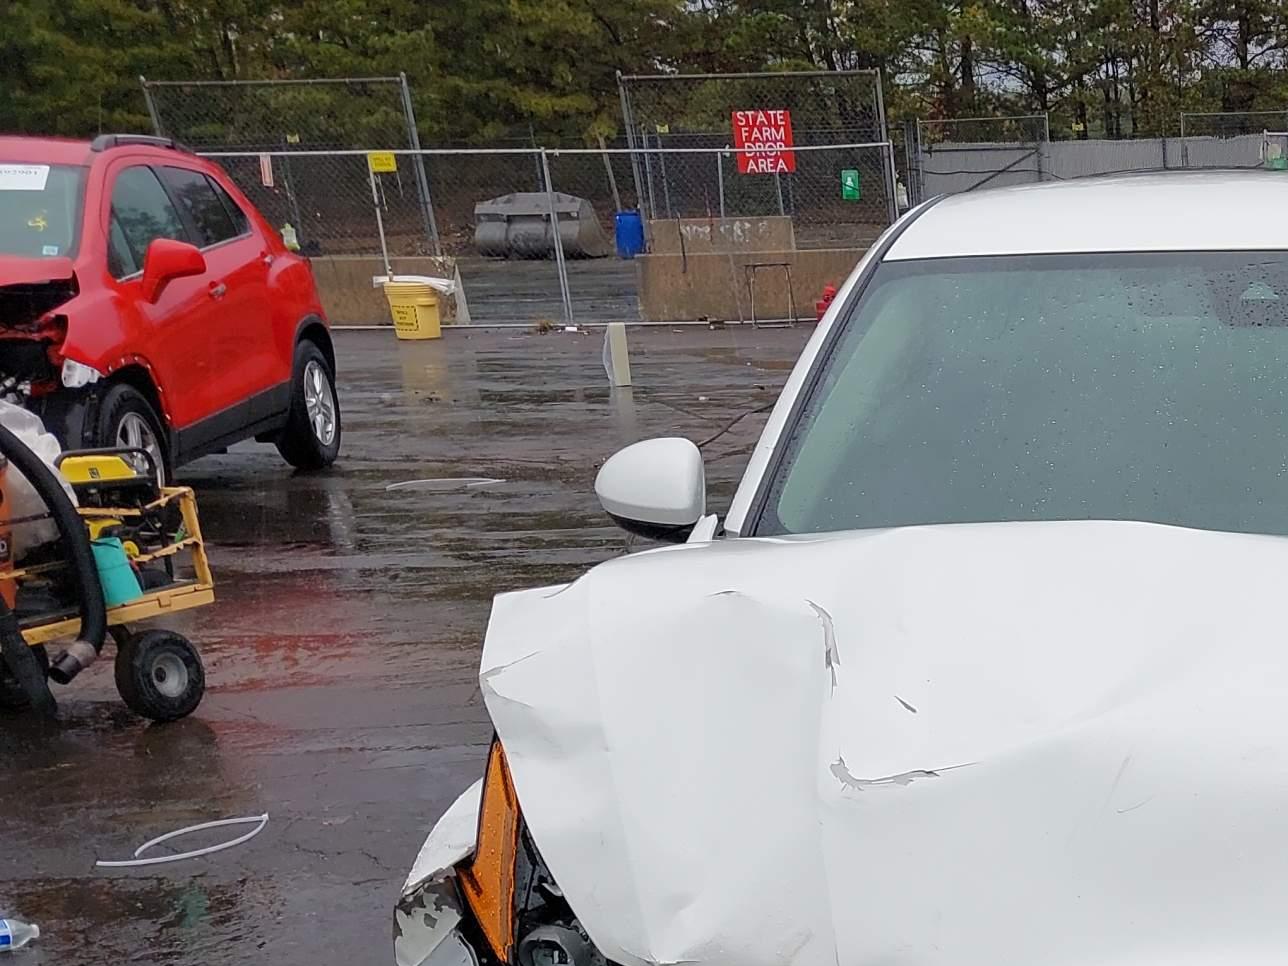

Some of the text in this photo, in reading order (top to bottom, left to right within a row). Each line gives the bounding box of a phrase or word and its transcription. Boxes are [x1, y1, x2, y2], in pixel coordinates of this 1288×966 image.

[736, 110, 785, 126] STATE
[741, 126, 785, 142] FARM
[744, 142, 785, 157] DROP
[747, 158, 788, 173] AREA
